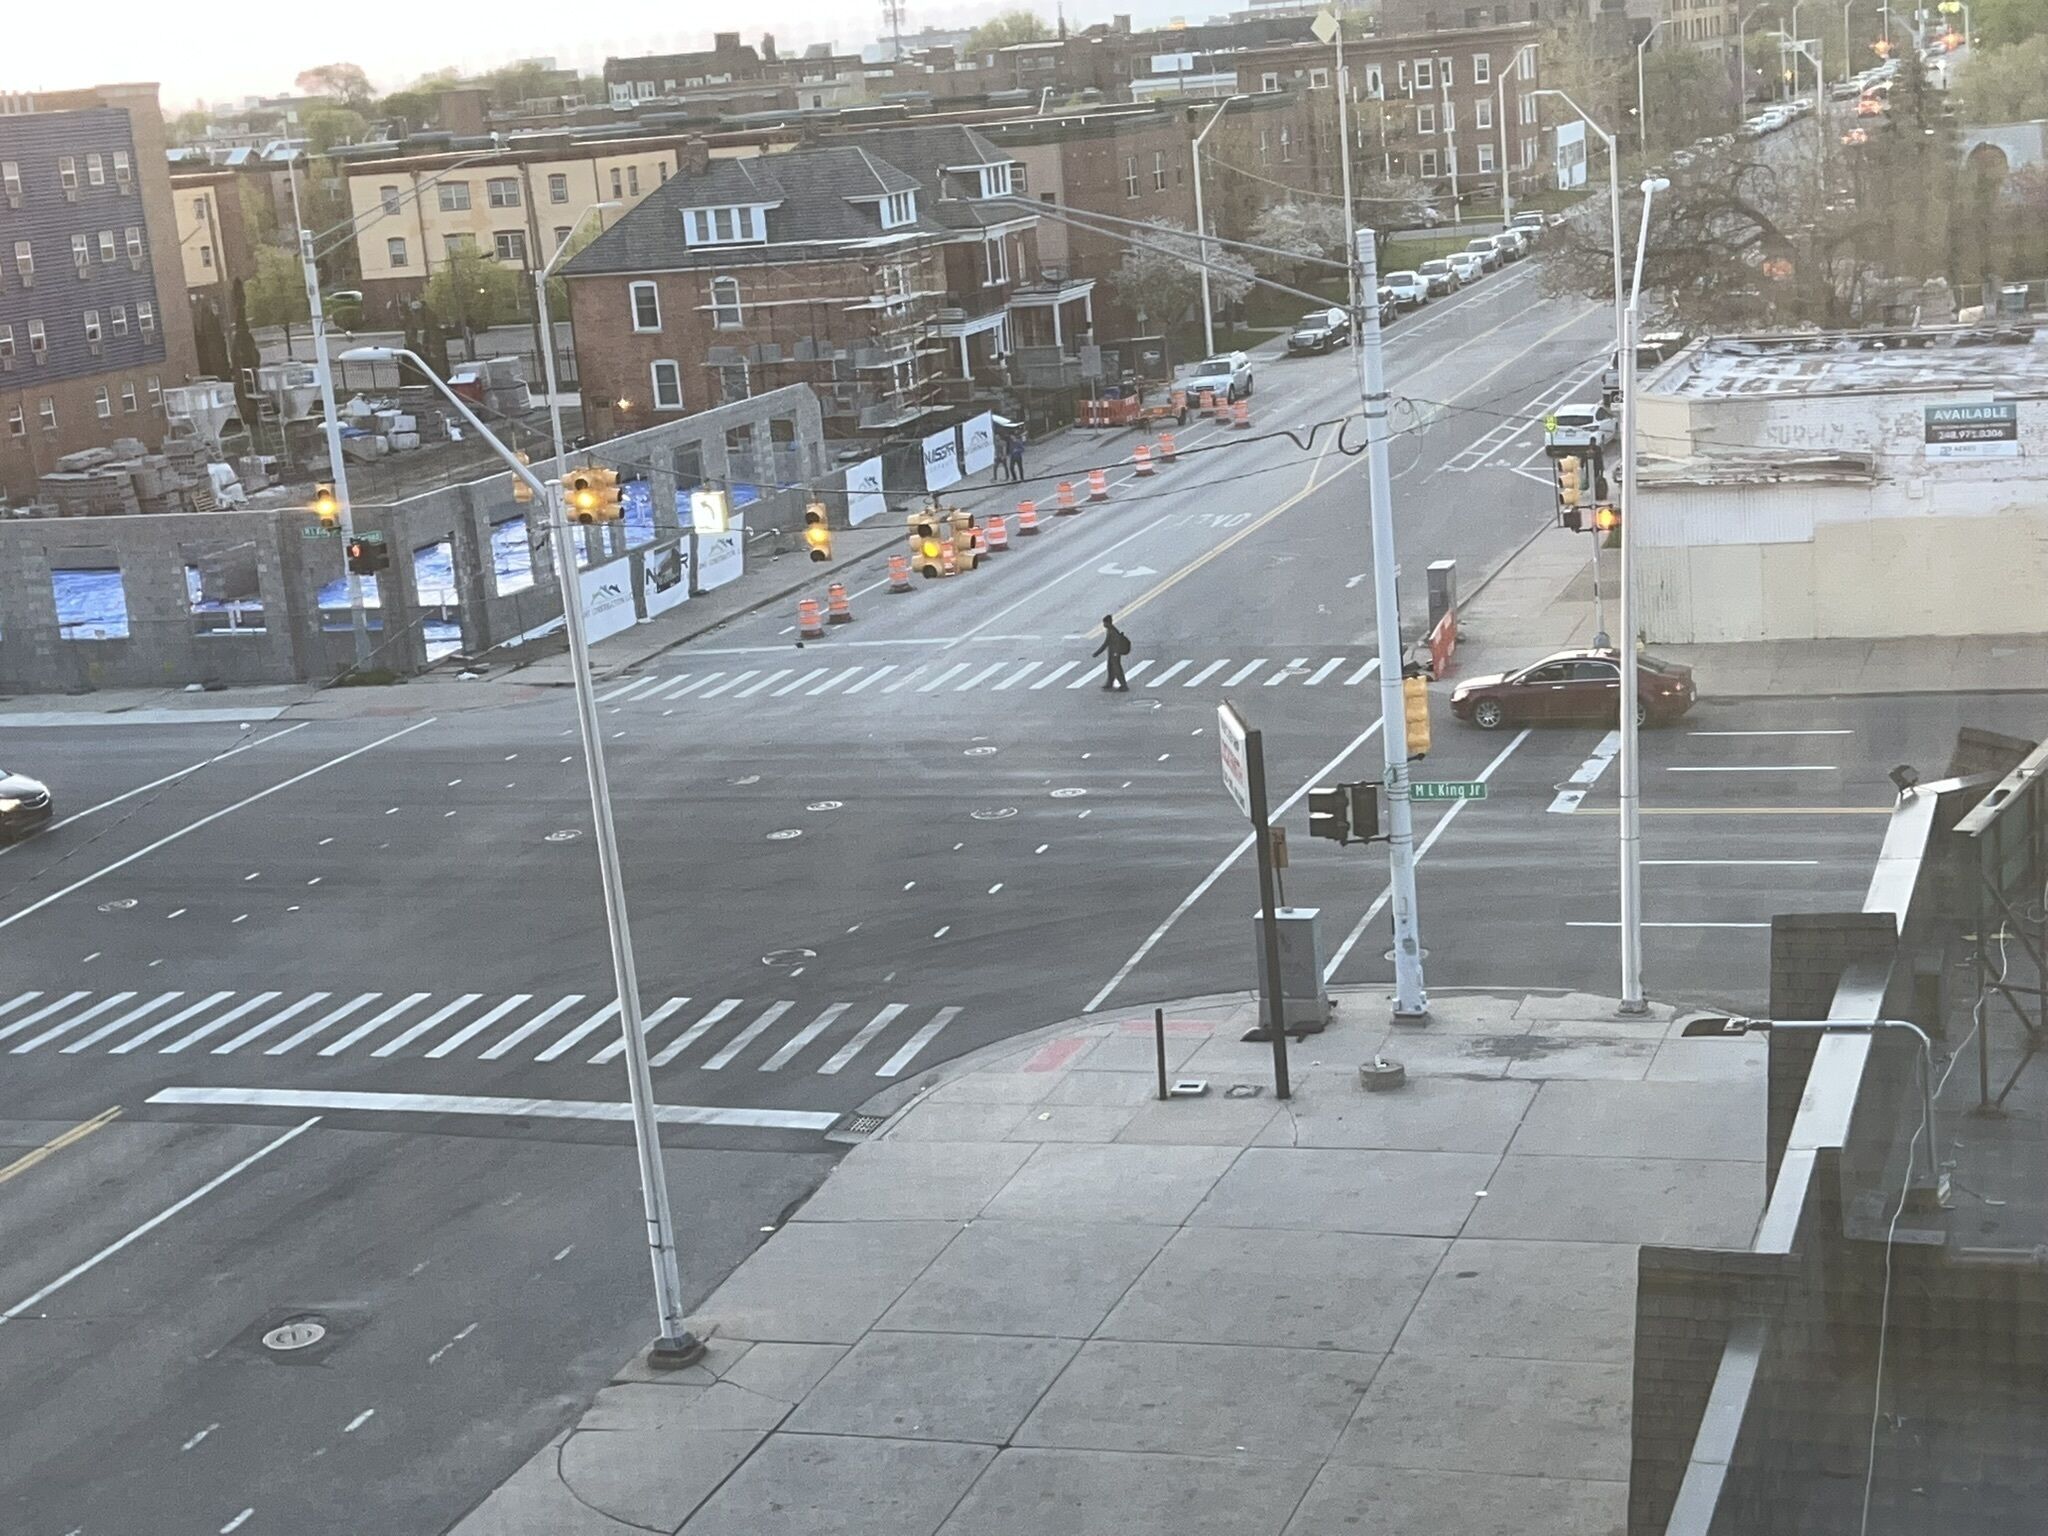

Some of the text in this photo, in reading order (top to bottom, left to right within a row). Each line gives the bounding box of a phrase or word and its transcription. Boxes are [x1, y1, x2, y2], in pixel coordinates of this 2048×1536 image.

[1934, 407, 2008, 420] AVAILABLE
[1415, 784, 1480, 798] M L King Jr
